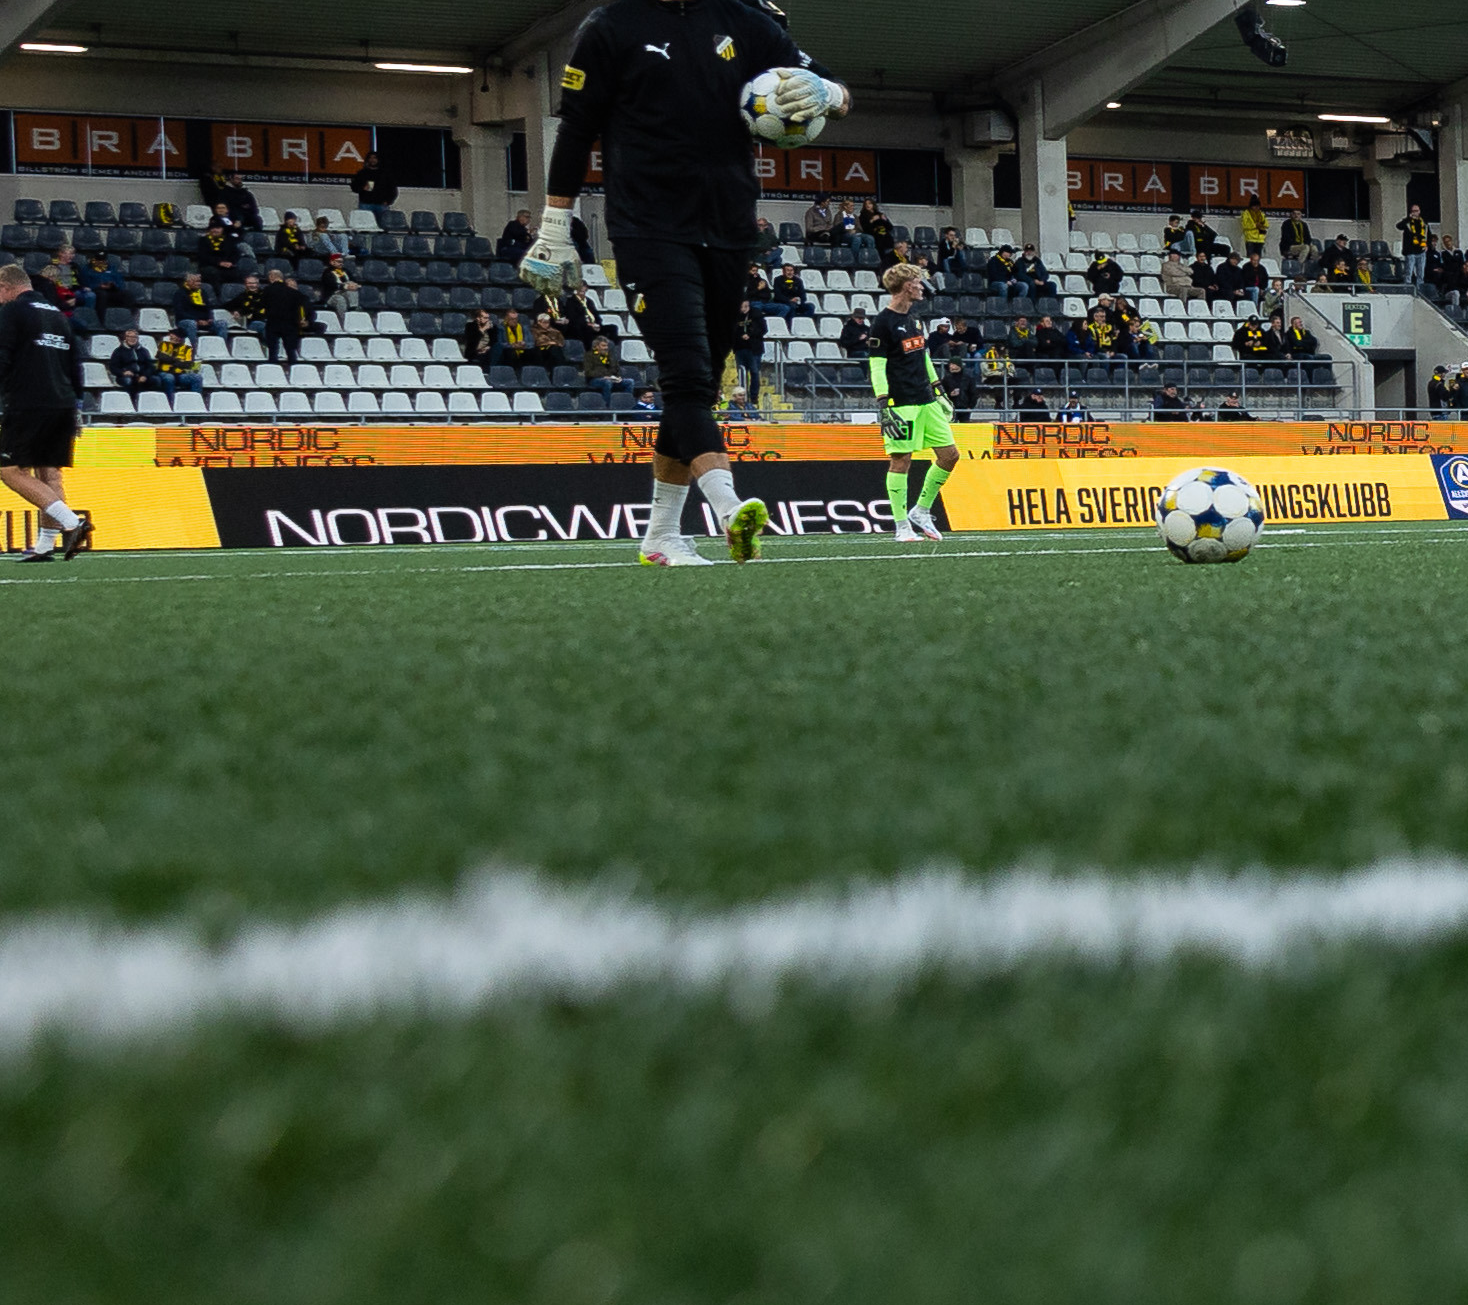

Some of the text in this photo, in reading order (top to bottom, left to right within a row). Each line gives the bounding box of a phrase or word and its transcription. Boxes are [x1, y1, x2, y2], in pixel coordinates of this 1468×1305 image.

[1350, 312, 1364, 333] E
[191, 427, 340, 452] NORDIC
[997, 424, 1111, 444] NORDIC
[1328, 423, 1430, 442] NORDIC
[1007, 487, 1072, 526] HELA
